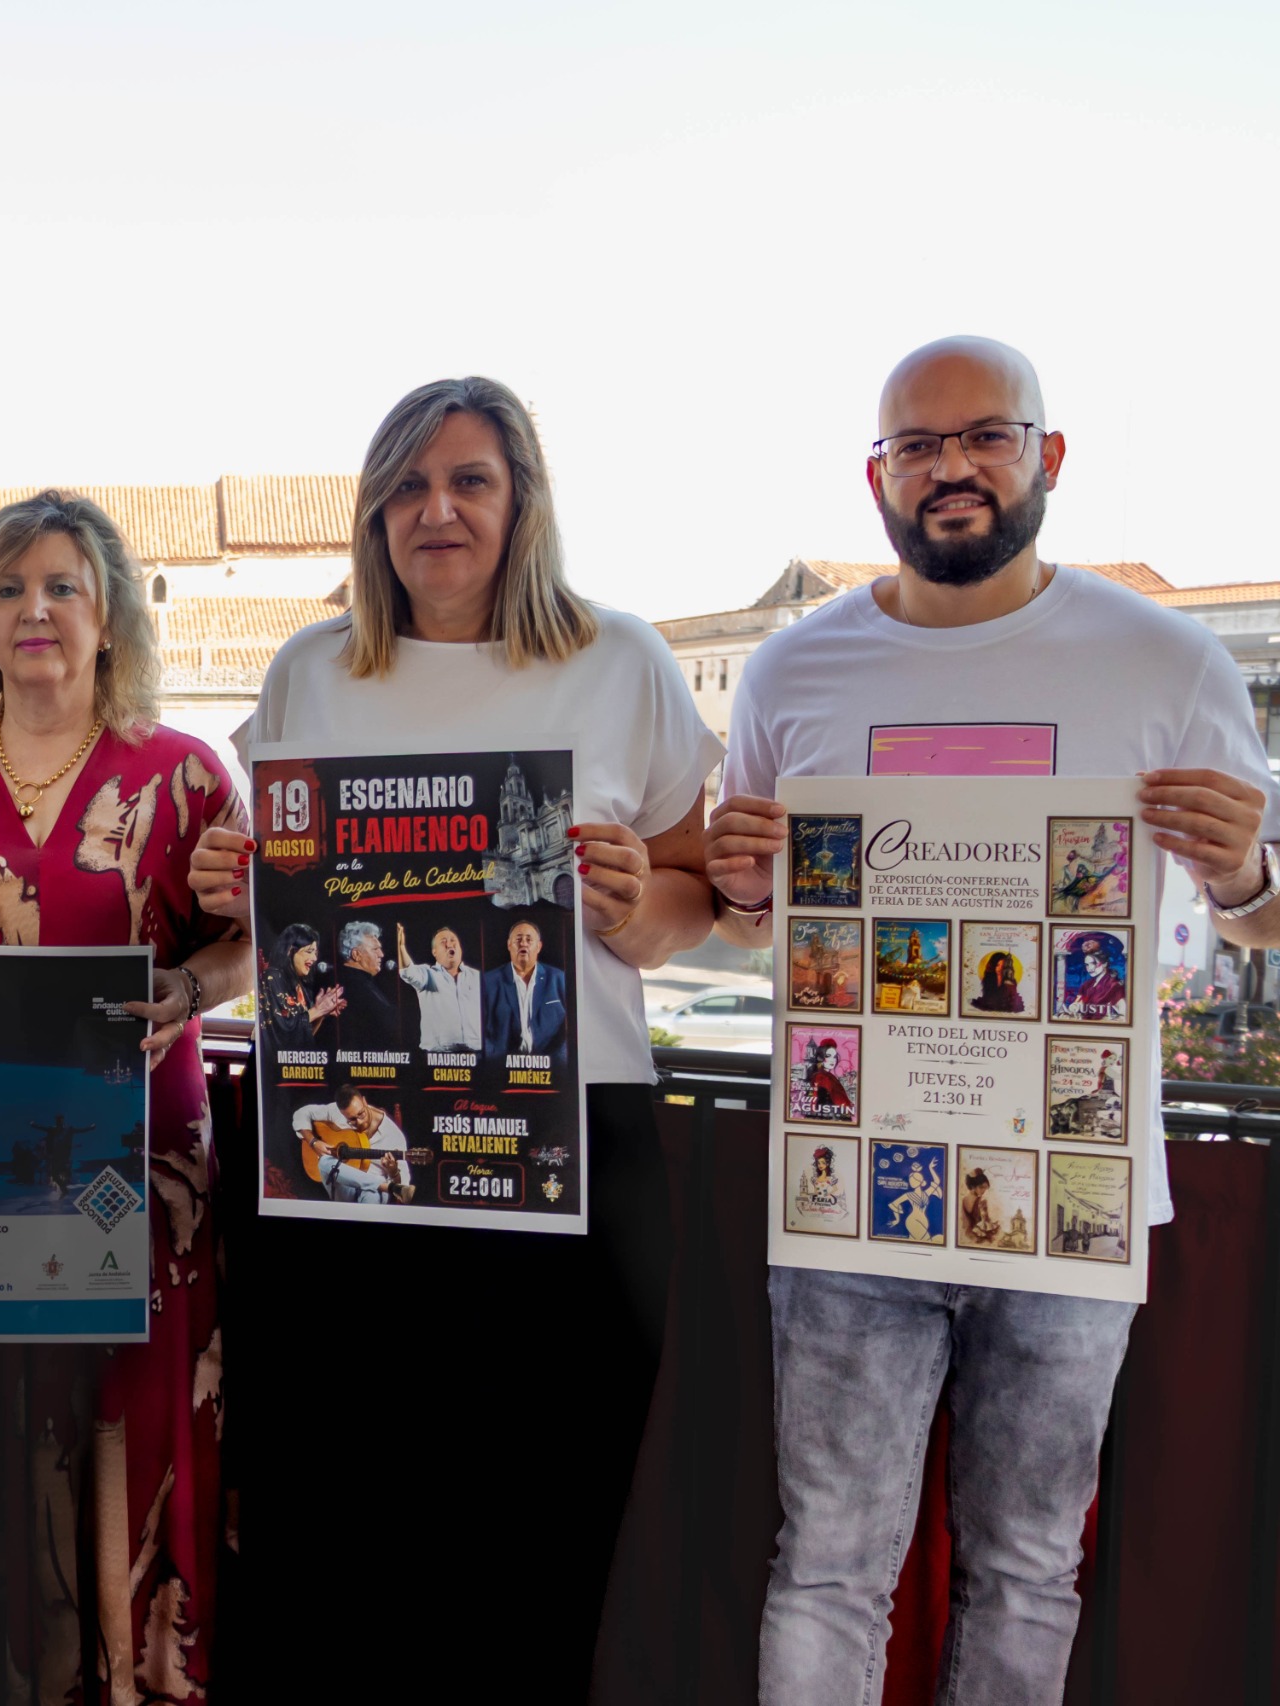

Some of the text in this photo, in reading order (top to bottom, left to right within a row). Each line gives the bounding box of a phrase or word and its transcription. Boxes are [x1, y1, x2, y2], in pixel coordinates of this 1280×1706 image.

[340, 775, 474, 811] ESCENARIO
[268, 779, 310, 832] 19
[335, 814, 488, 854] FLAMENCO
[265, 838, 315, 857] AGOSTO
[864, 819, 1041, 871] CREADORES
[336, 858, 363, 871] en la
[324, 862, 496, 901] Plaza de la Catedral
[874, 874, 1030, 886] EXPOSICIÓN-CONFERENCIA
[869, 886, 1040, 898] DE CARTELES CONCURSANTES
[871, 897, 1034, 909] FERIA DE SAN AGUSTÍN 2026
[888, 1025, 1028, 1043] PATIO DEL MUSEO
[336, 1050, 410, 1064] ÁNGEL FERNÁNDEZ
[907, 1042, 1008, 1058] ETNOLÓGICO
[277, 1051, 328, 1064] MERCEDES
[427, 1053, 476, 1067] MAURICIO
[506, 1055, 550, 1069] ANTONIO
[282, 1066, 325, 1079] GARROTE
[351, 1066, 396, 1078] NARANJITO
[433, 1068, 471, 1082] CHAVES
[508, 1069, 551, 1084] JIMÉNEZ
[908, 1072, 994, 1089] JUEVES, 20
[454, 1099, 468, 1111] Al
[923, 1091, 982, 1106] 21:30 H
[792, 1102, 855, 1115] AGUSTÍN
[432, 1114, 529, 1136] JESÚS MANUEL
[442, 1135, 518, 1155] REVALIENTE
[467, 1164, 493, 1175] Hora:
[450, 1176, 513, 1198] 22:00H
[7, 1283, 13, 1291] h
